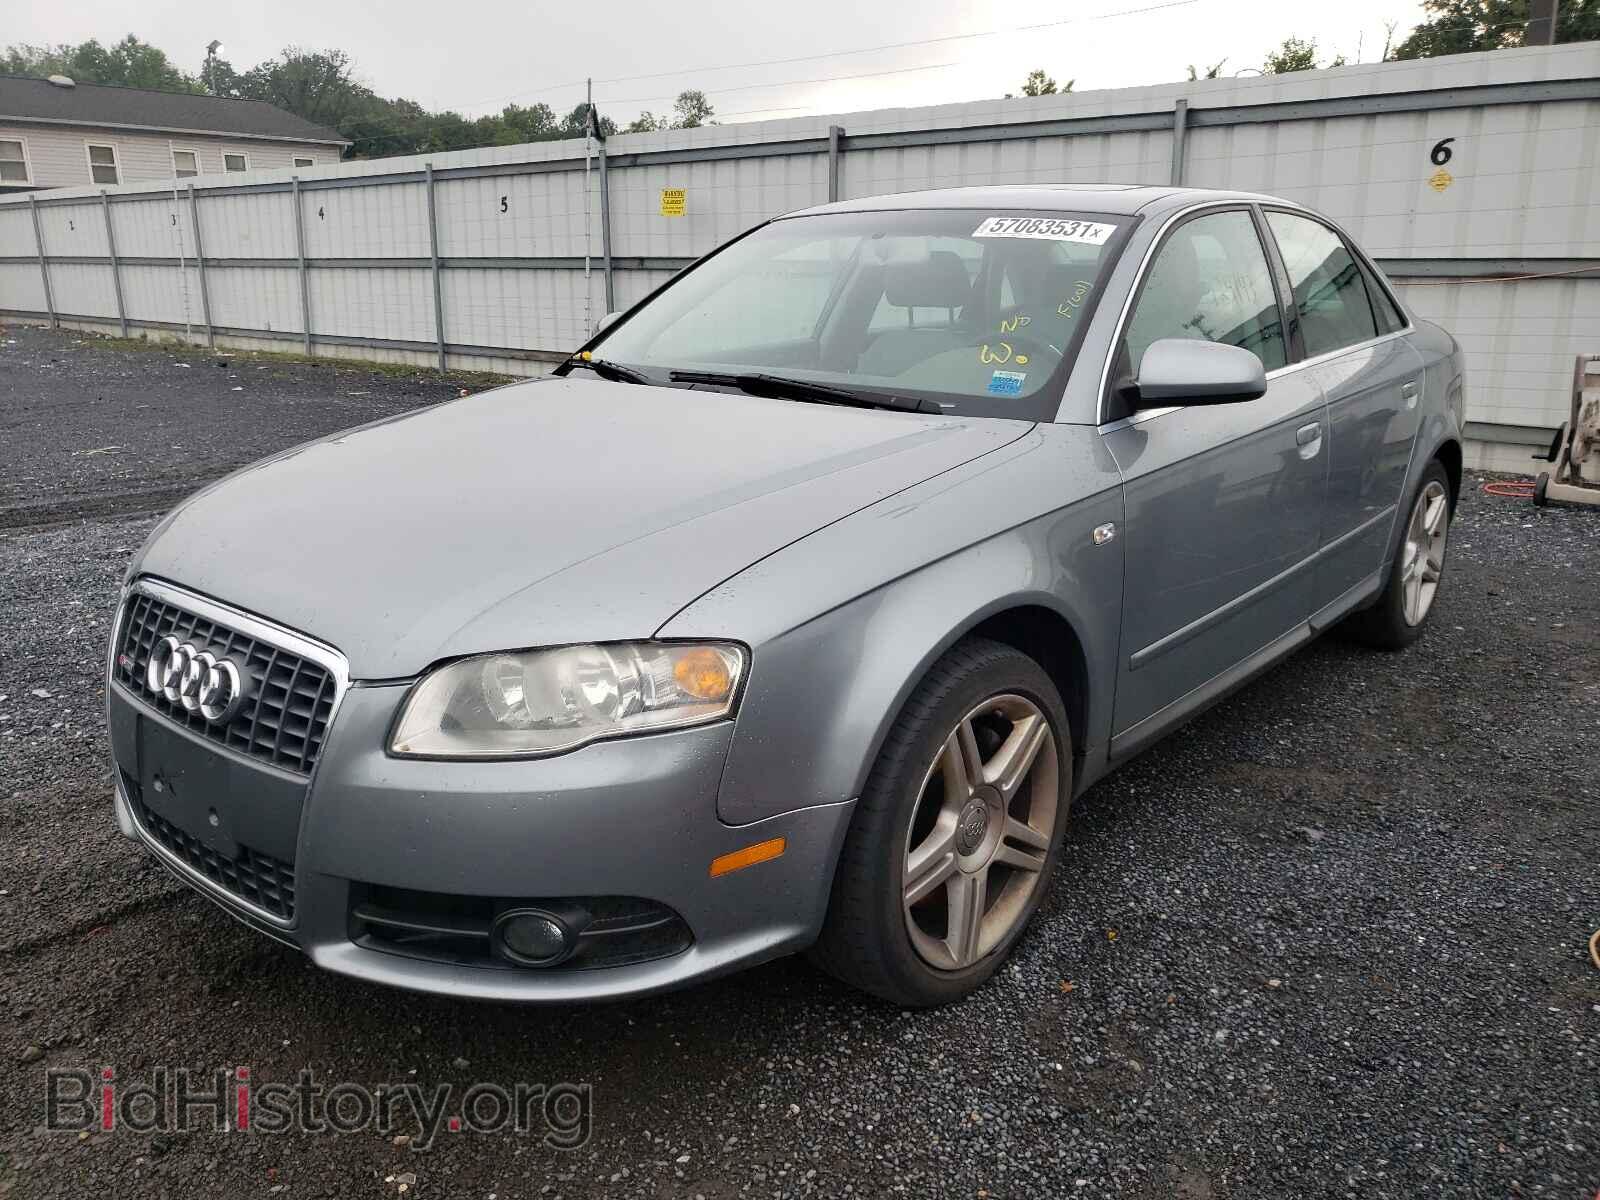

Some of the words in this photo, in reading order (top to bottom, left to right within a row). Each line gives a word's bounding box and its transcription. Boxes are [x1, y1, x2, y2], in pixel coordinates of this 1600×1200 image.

[1431, 137, 1456, 166] 6
[500, 196, 508, 213] 5
[318, 206, 325, 221] 4
